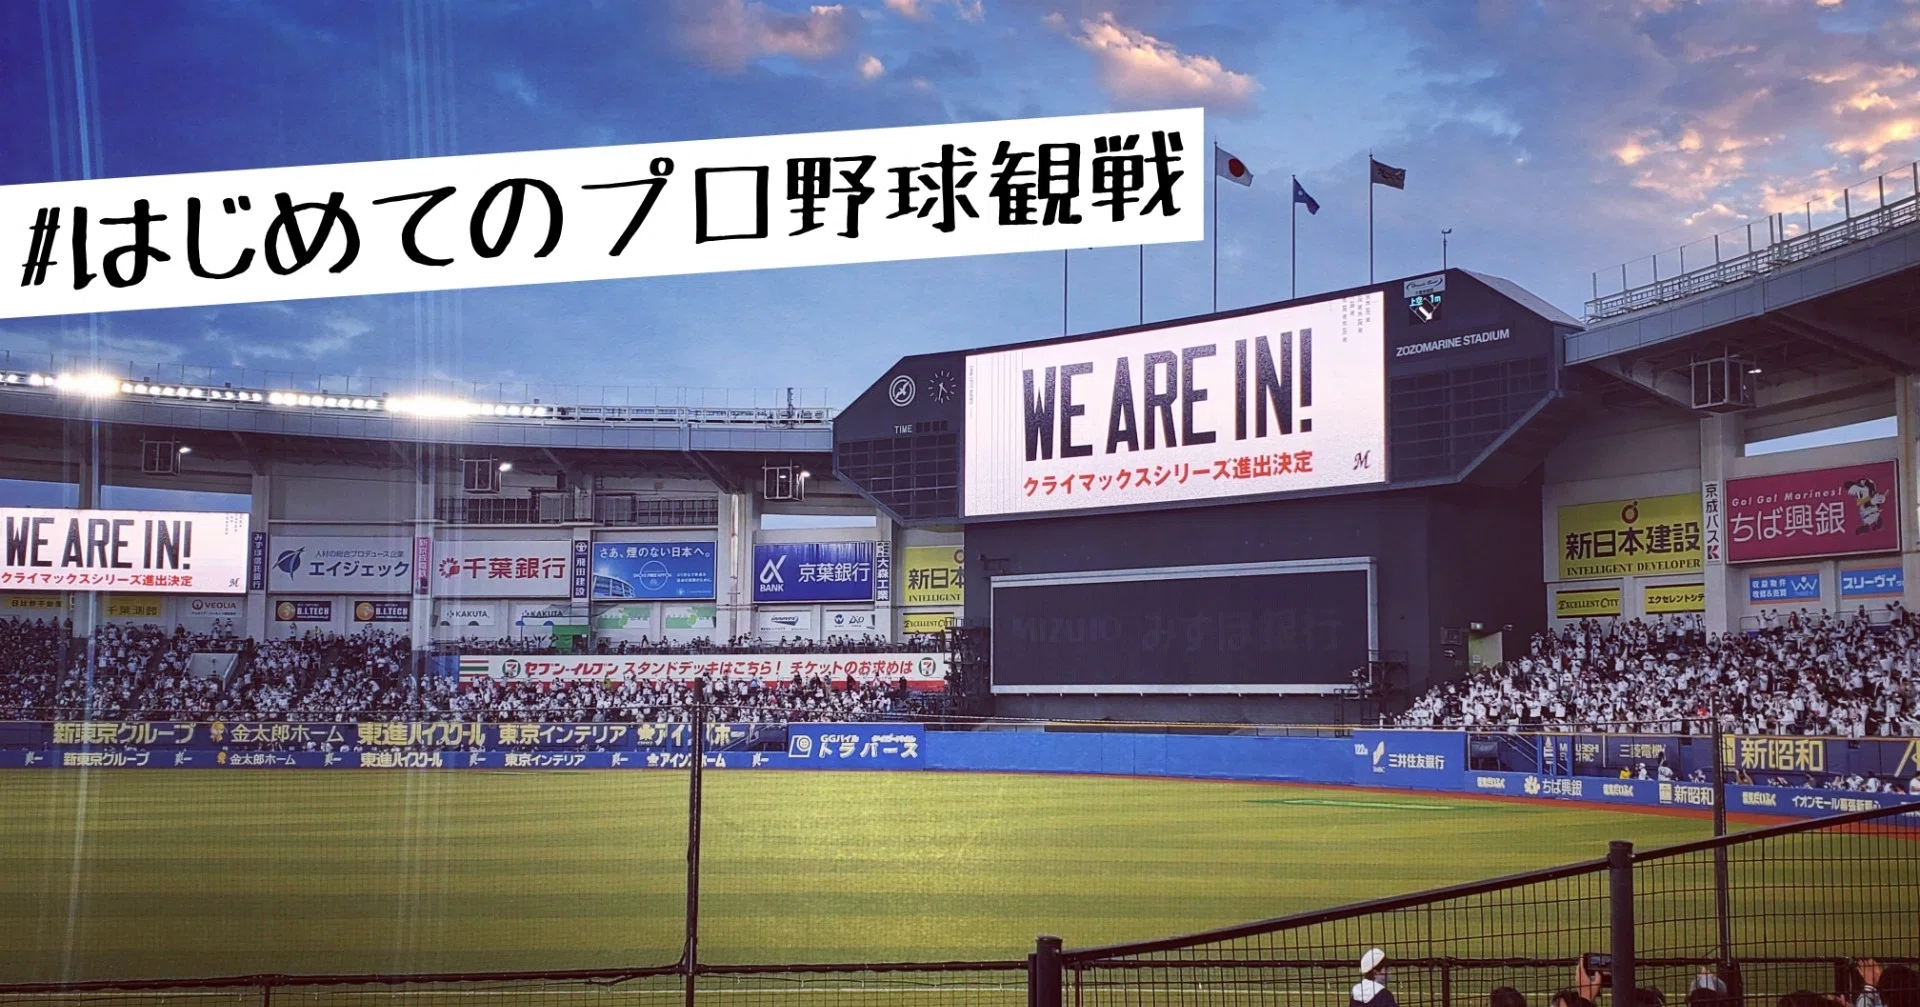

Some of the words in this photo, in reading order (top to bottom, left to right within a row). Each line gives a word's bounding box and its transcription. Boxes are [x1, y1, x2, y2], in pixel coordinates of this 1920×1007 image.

[1396, 336, 1462, 357] ZOZOMARINE
[1463, 328, 1510, 346] STADIUM
[1022, 361, 1094, 462] WE
[1105, 343, 1217, 455] ARE
[1235, 328, 1313, 441] IN!
[894, 425, 913, 434] TIME
[1023, 450, 1314, 497] クライマックスシリーズ進出決定
[1731, 497, 1753, 507] Go!
[1757, 494, 1778, 504] Go!
[1784, 487, 1843, 501] Marines!
[1705, 483, 1720, 544] 京成バス
[1730, 502, 1846, 543] ちば興銀
[6, 516, 55, 567] WE
[61, 517, 134, 569] ARE
[143, 519, 193, 570] IN!
[1565, 522, 1701, 561] 新日本建設
[600, 546, 711, 558] さあ、煙のない日本へ。
[309, 561, 410, 577] エイジェック
[463, 557, 566, 579] 千葉銀行
[575, 557, 587, 597] 飛田建設
[798, 562, 871, 583] 京葉銀行
[1567, 563, 1634, 576] INTELLIGENT
[1637, 558, 1701, 572] DEVELOPER
[1, 571, 193, 587] クライマックスシリーズ進出決定
[760, 584, 784, 592] BANK
[876, 558, 890, 600] 大森工業
[205, 602, 237, 610] VEOLIA
[908, 593, 960, 603] INTELLIGENT
[530, 610, 563, 618] KAKUTA
[790, 660, 913, 675] チケットのお求めは
[53, 723, 196, 745] 新東京グループ
[230, 723, 345, 743] 金太郎ホーム
[357, 722, 487, 746] 東進ハイスクール
[498, 724, 627, 744] 東京インテリア
[63, 752, 150, 767] 新東京グループ
[229, 754, 296, 766] 金太郎ホーム
[360, 752, 443, 768] 東進ハイスクール
[504, 753, 586, 767] 東京インテリア
[818, 743, 918, 758] トラバース
[1741, 738, 1824, 772] 新昭和
[1389, 754, 1445, 770] 三井住友銀行
[1541, 778, 1583, 797] ちば興銀
[1674, 786, 1715, 806] 新昭和
